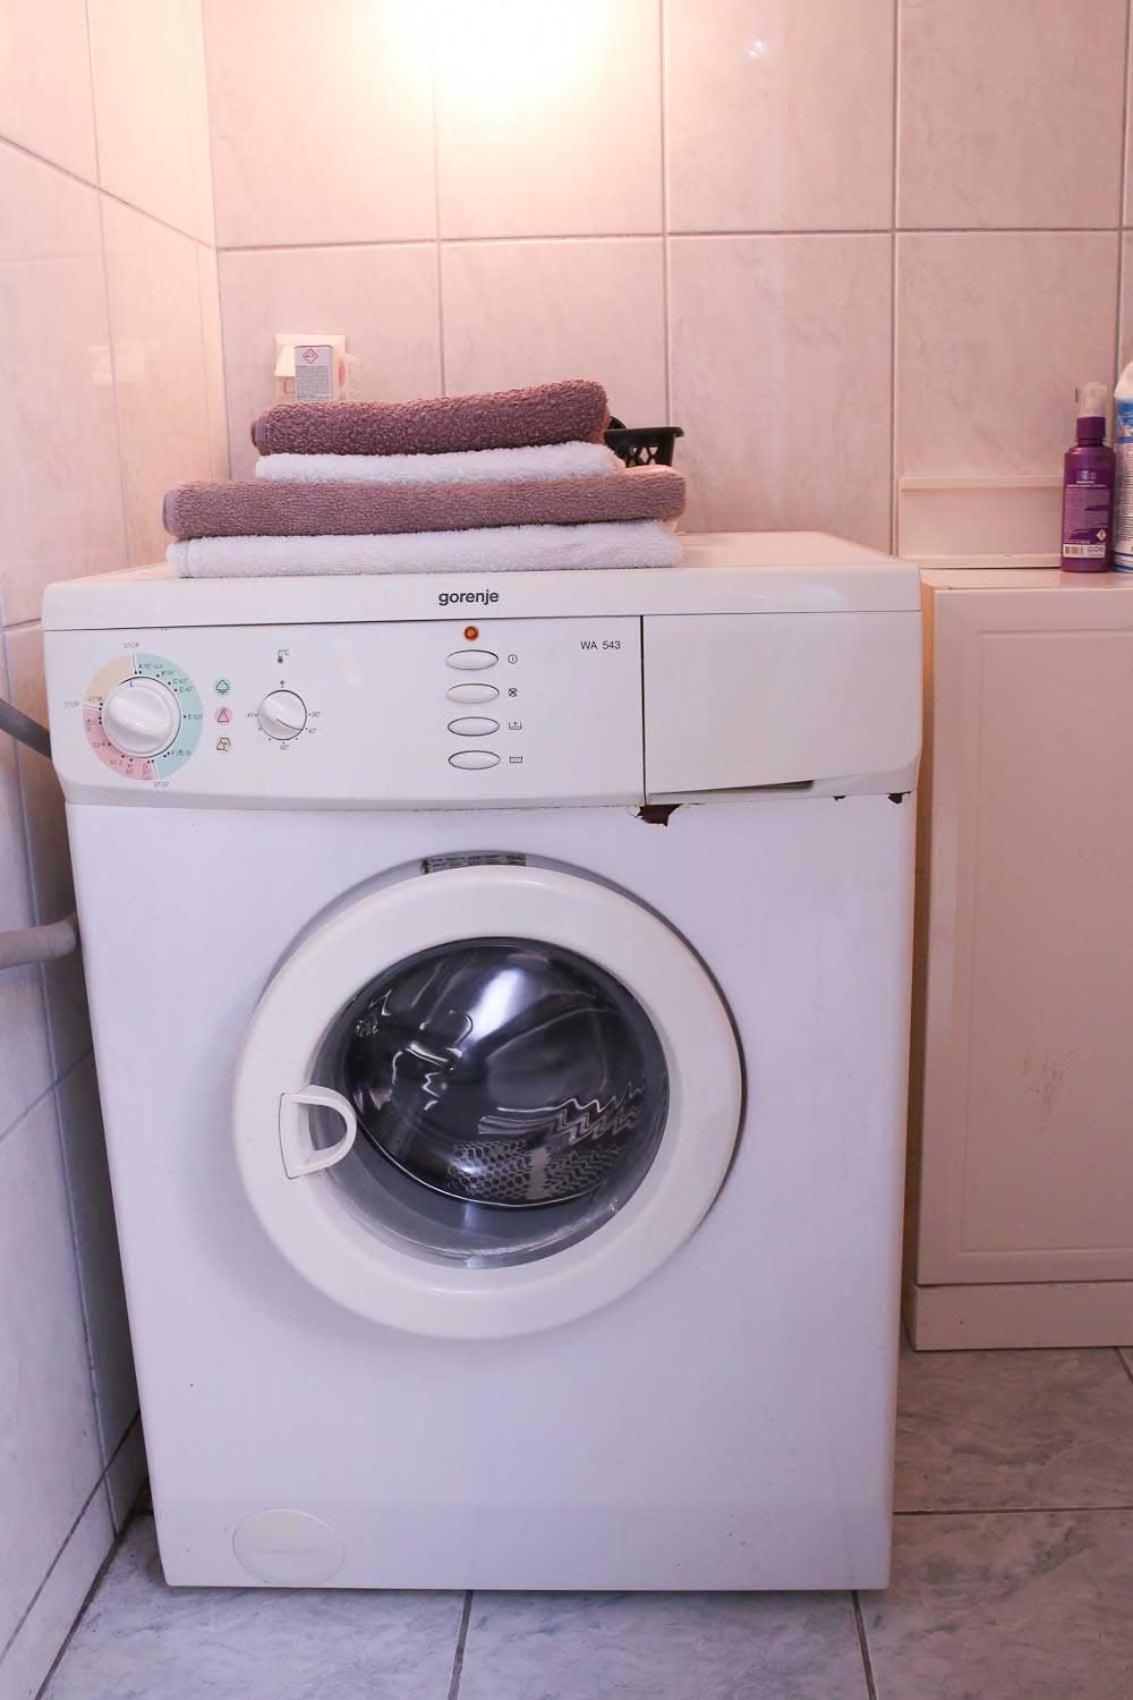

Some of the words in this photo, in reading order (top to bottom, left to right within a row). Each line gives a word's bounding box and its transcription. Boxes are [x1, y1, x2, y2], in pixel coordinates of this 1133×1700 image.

[438, 589, 499, 606] gorenje
[580, 641, 598, 650] WA
[602, 640, 621, 650] 543
